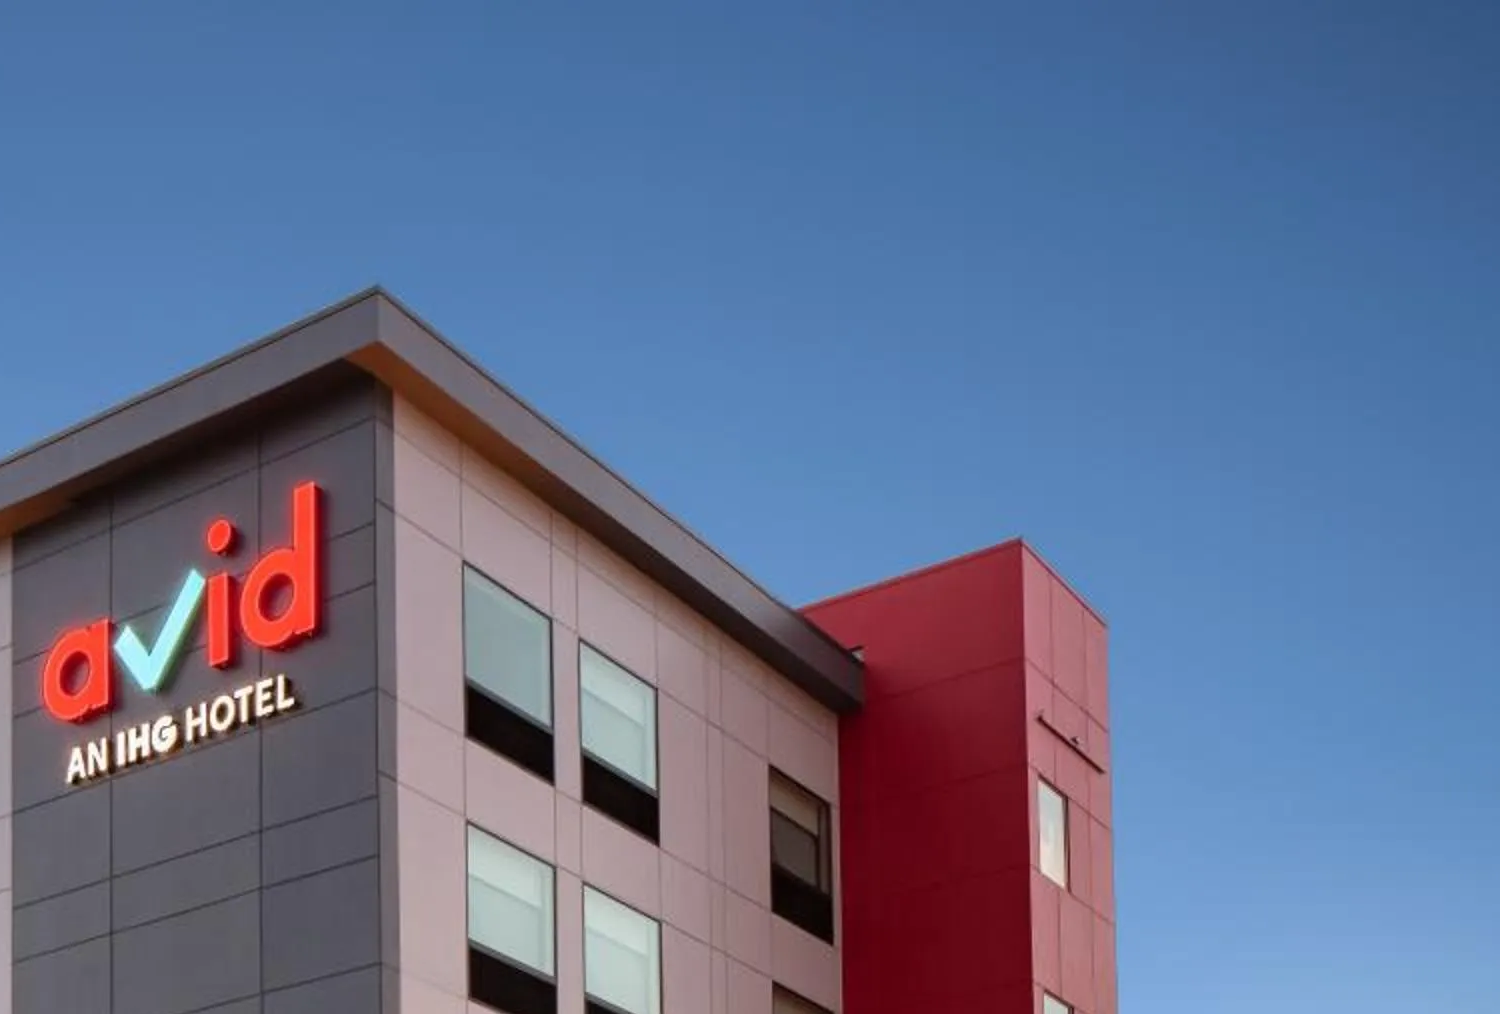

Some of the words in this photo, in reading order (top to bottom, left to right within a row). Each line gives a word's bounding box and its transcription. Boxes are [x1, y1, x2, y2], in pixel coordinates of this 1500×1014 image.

[42, 481, 319, 722] avid
[66, 737, 108, 784] AN
[116, 715, 178, 768] IHG
[185, 673, 297, 743] HOTEL
